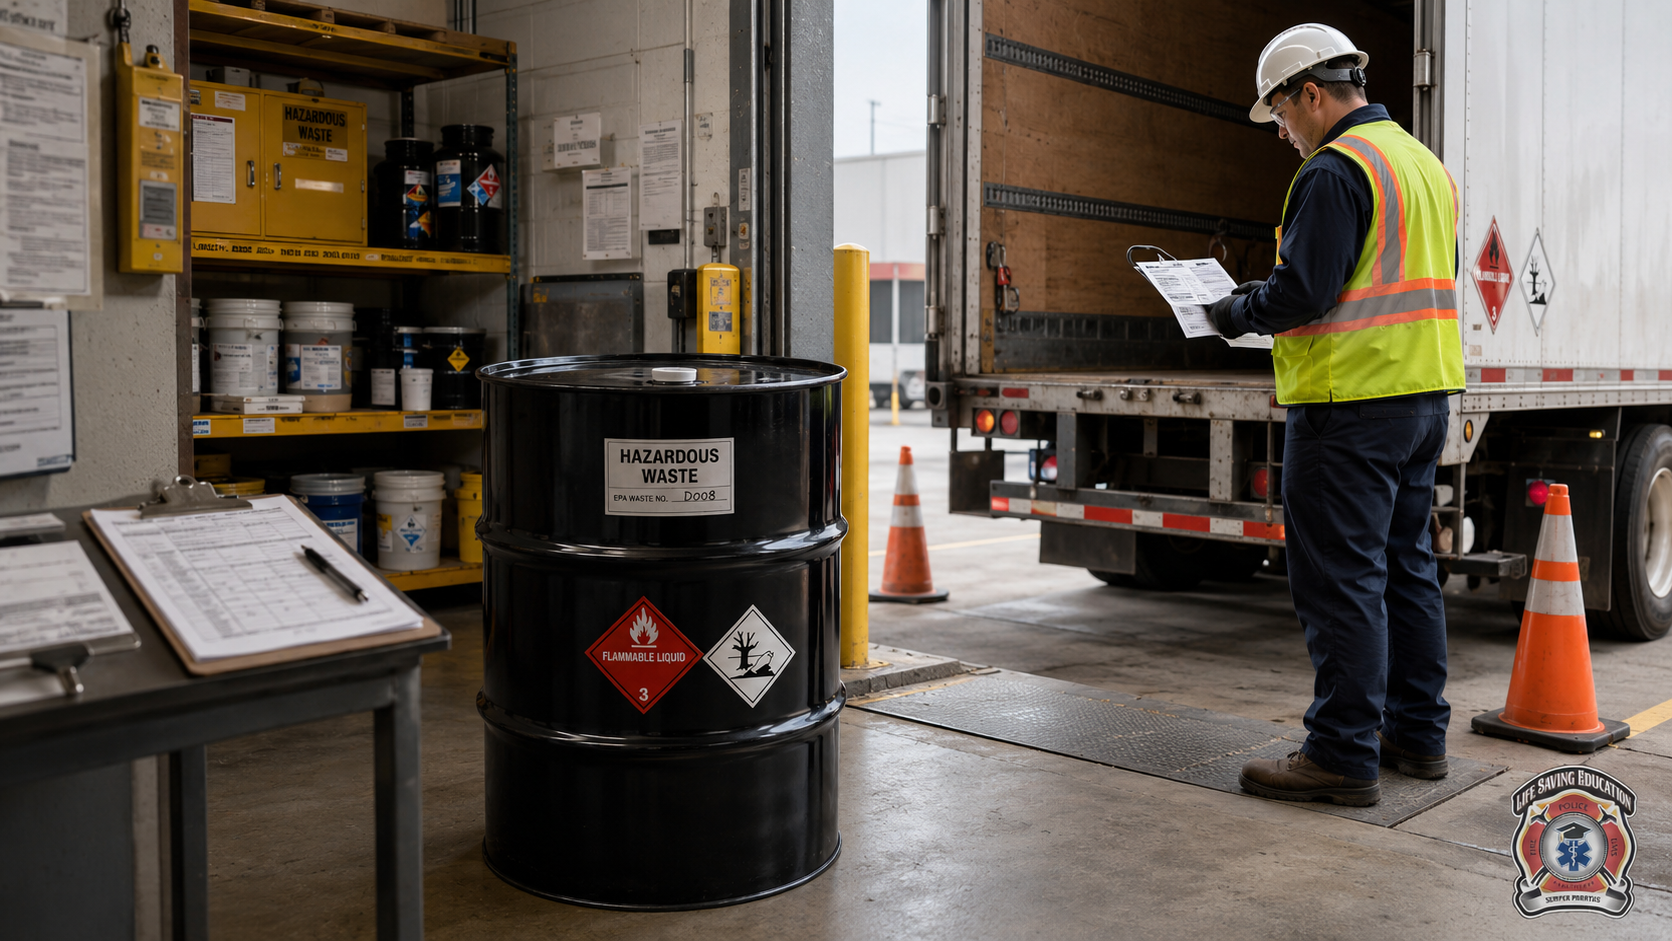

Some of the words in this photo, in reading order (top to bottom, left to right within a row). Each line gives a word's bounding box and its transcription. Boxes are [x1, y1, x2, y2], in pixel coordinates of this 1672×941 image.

[285, 106, 346, 127] HAZARDOUS
[298, 125, 332, 142] WASTE
[1491, 306, 1497, 321] 3
[620, 448, 719, 464] HAZARDOUS
[641, 468, 698, 484] WASTE
[613, 494, 628, 502] EPA
[629, 494, 654, 503] WASTE
[655, 495, 669, 503] NO.
[684, 490, 716, 502] D008
[602, 651, 655, 663] FLAMMABLE
[657, 652, 686, 664] LIQUID
[639, 687, 649, 702] 3
